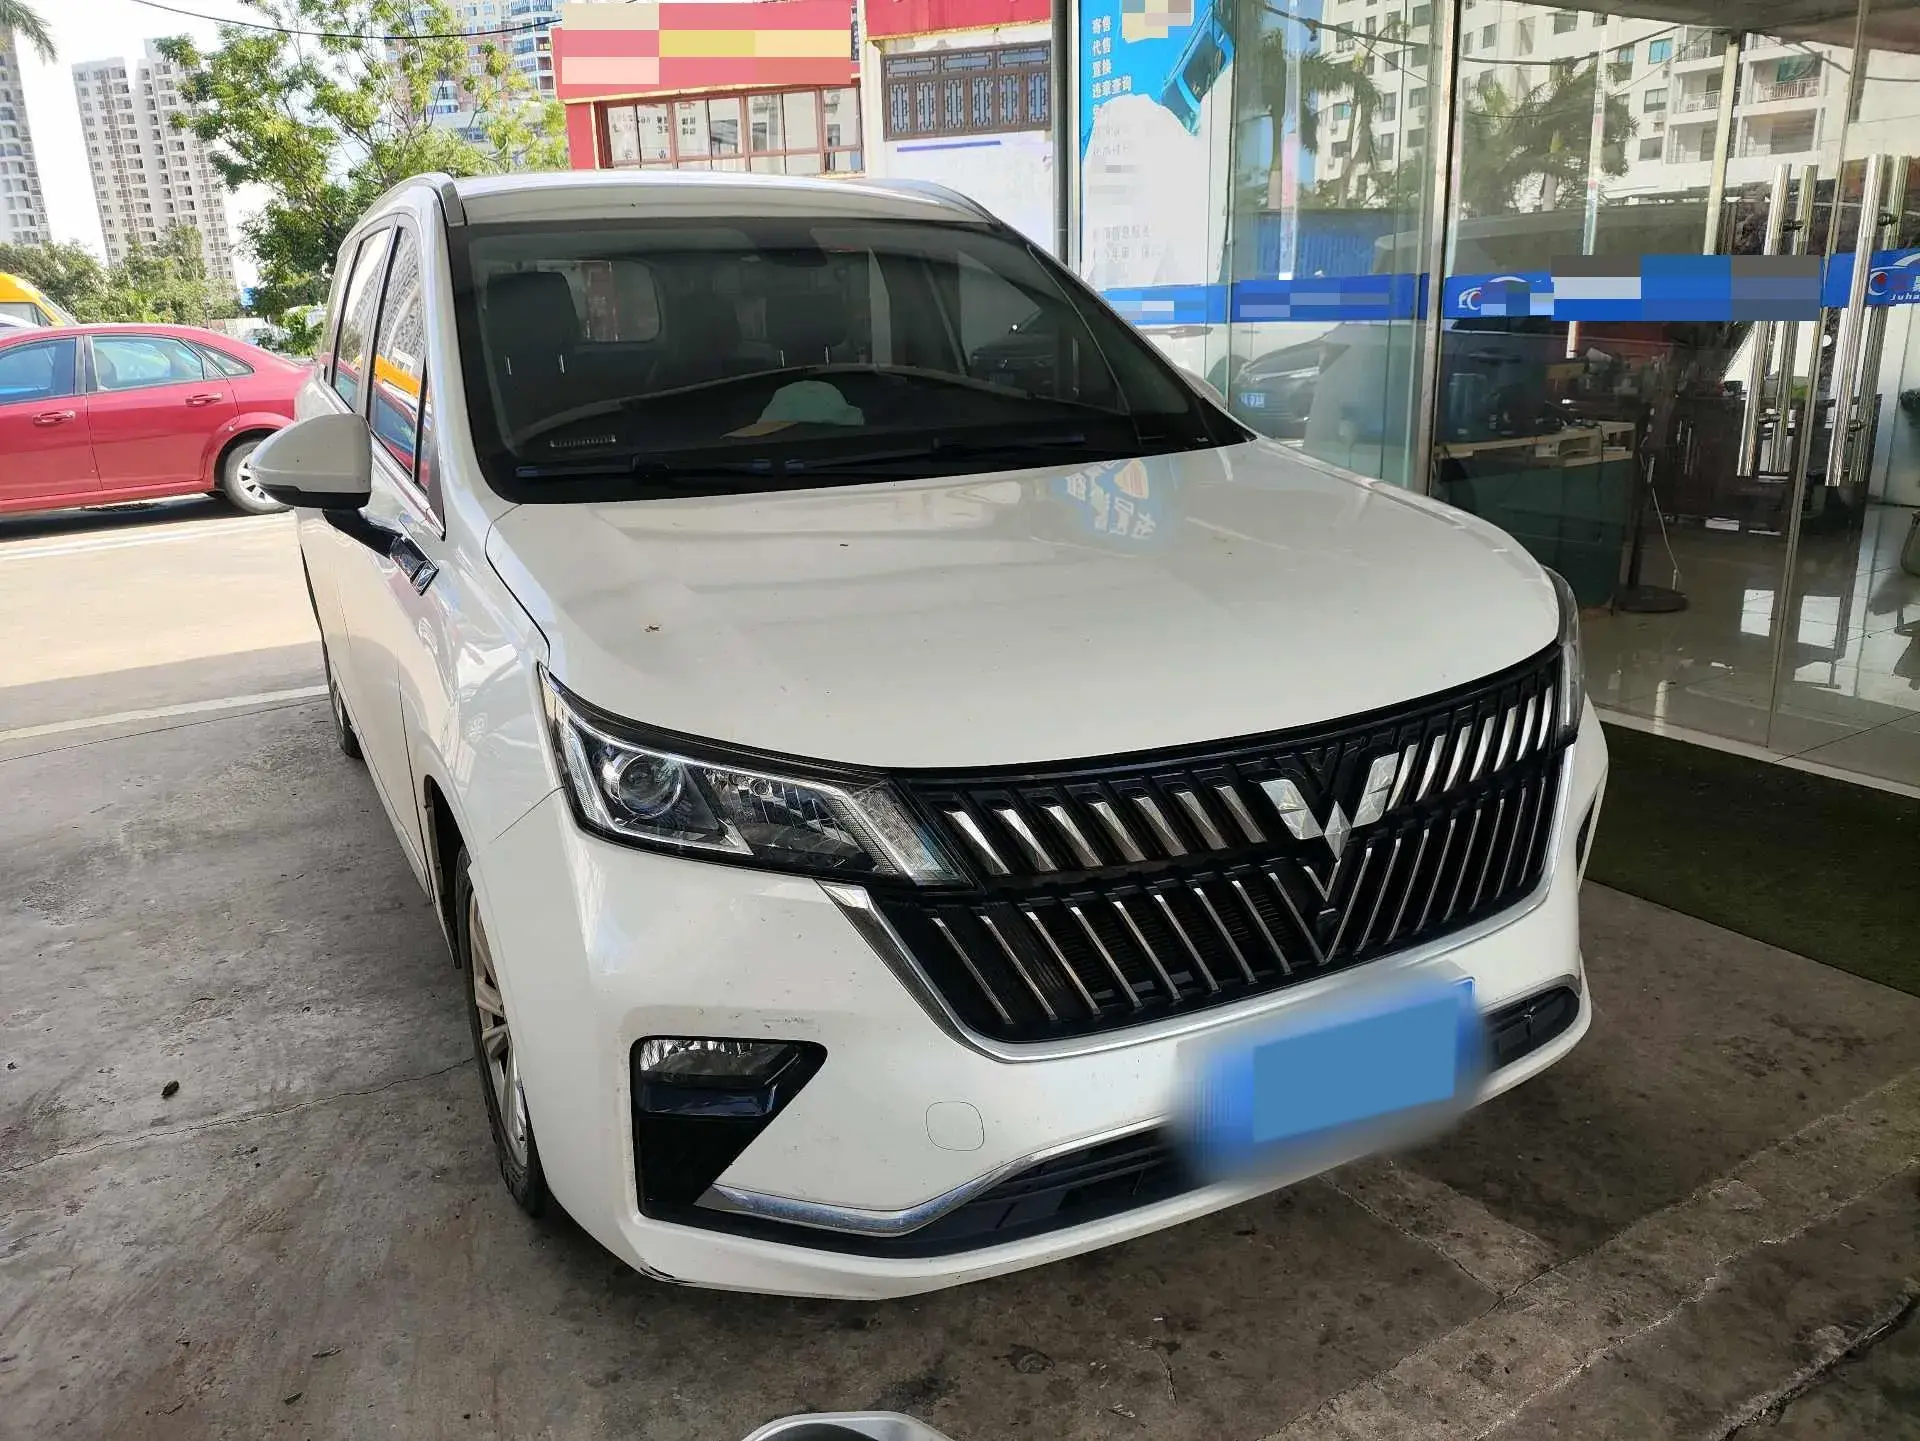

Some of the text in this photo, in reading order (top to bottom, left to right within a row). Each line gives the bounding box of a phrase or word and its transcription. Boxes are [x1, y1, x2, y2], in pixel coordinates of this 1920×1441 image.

[1092, 37, 1111, 56] 代售
[1092, 58, 1111, 78] 置换
[1092, 75, 1132, 98] 违章查询
